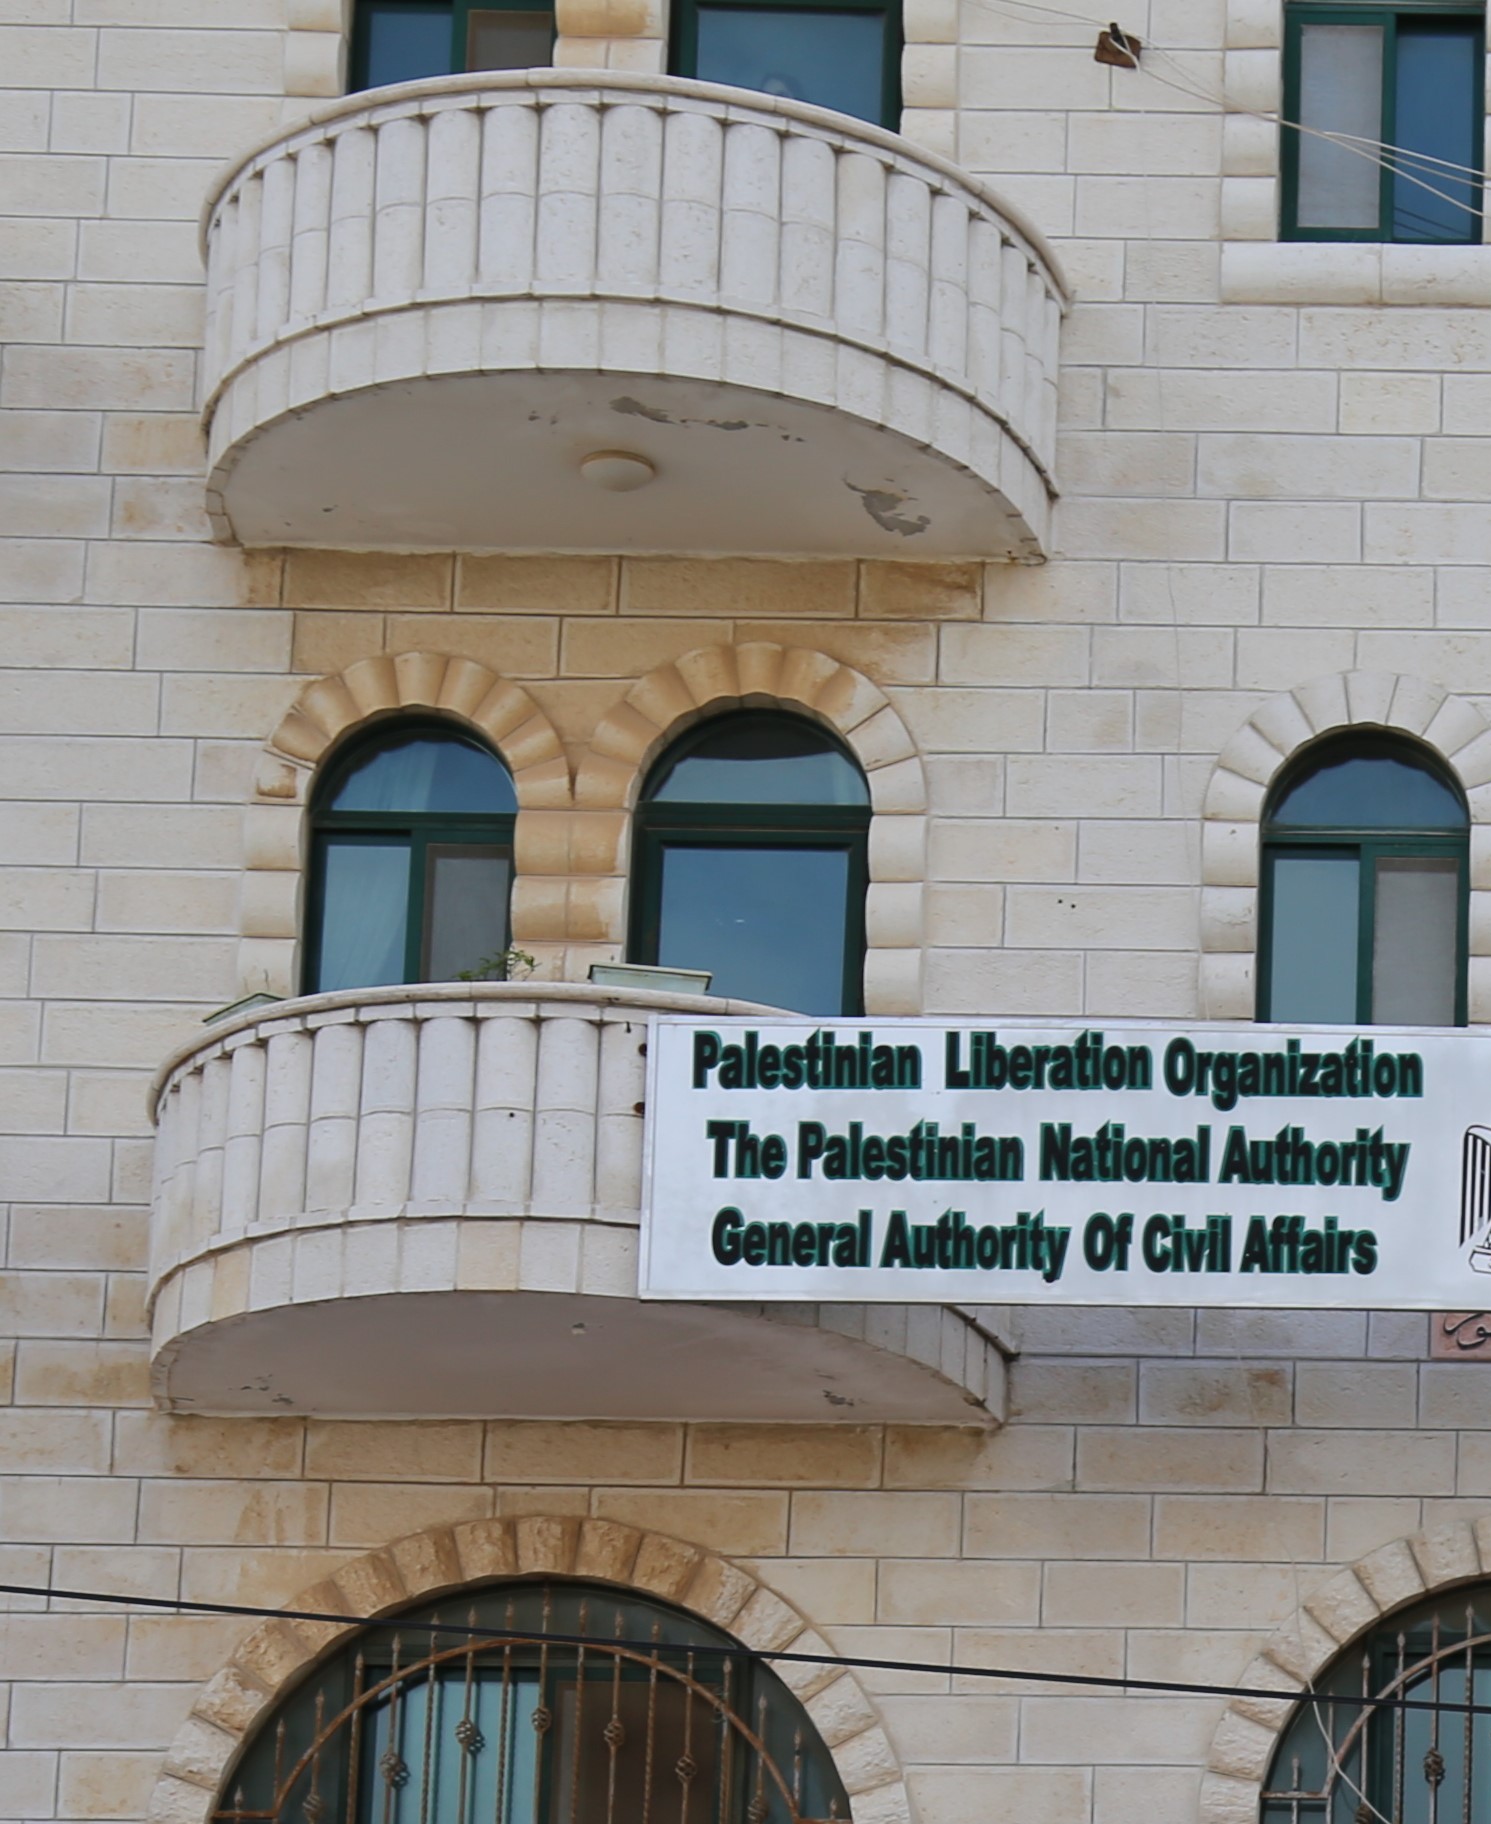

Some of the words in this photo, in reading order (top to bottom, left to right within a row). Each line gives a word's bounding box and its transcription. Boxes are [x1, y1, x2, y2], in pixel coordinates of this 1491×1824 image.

[692, 1028, 923, 1090] Palestinian
[945, 1028, 1153, 1091] Liberation
[1163, 1035, 1424, 1111] Organization
[706, 1119, 788, 1180] The
[796, 1118, 1025, 1182] Palestinian
[1039, 1119, 1212, 1183] National
[1217, 1123, 1411, 1202] Authority
[711, 1206, 873, 1268] General
[878, 1206, 1072, 1284] Authority
[1083, 1212, 1135, 1272] Of
[1142, 1213, 1233, 1273] Civil
[1238, 1214, 1378, 1276] Affairs
